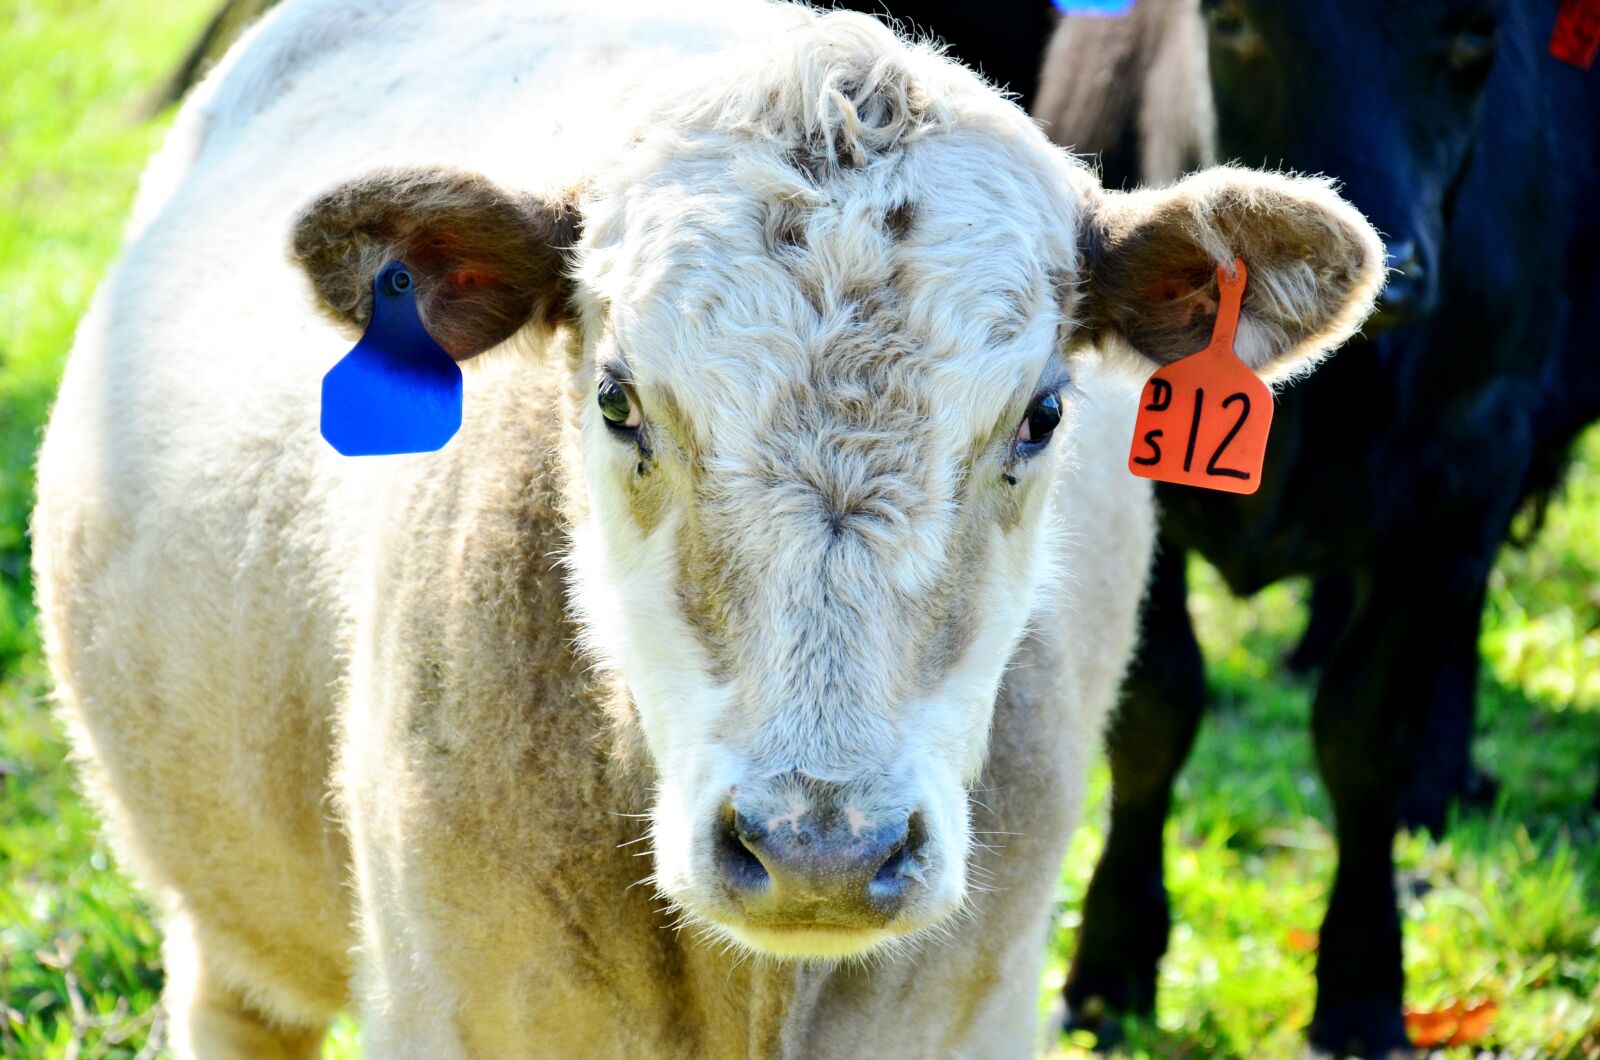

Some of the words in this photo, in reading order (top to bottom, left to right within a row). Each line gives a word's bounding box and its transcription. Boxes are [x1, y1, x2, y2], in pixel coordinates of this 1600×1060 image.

[1145, 378, 1172, 411] D
[1133, 429, 1163, 466] S
[1183, 387, 1250, 480] 12
